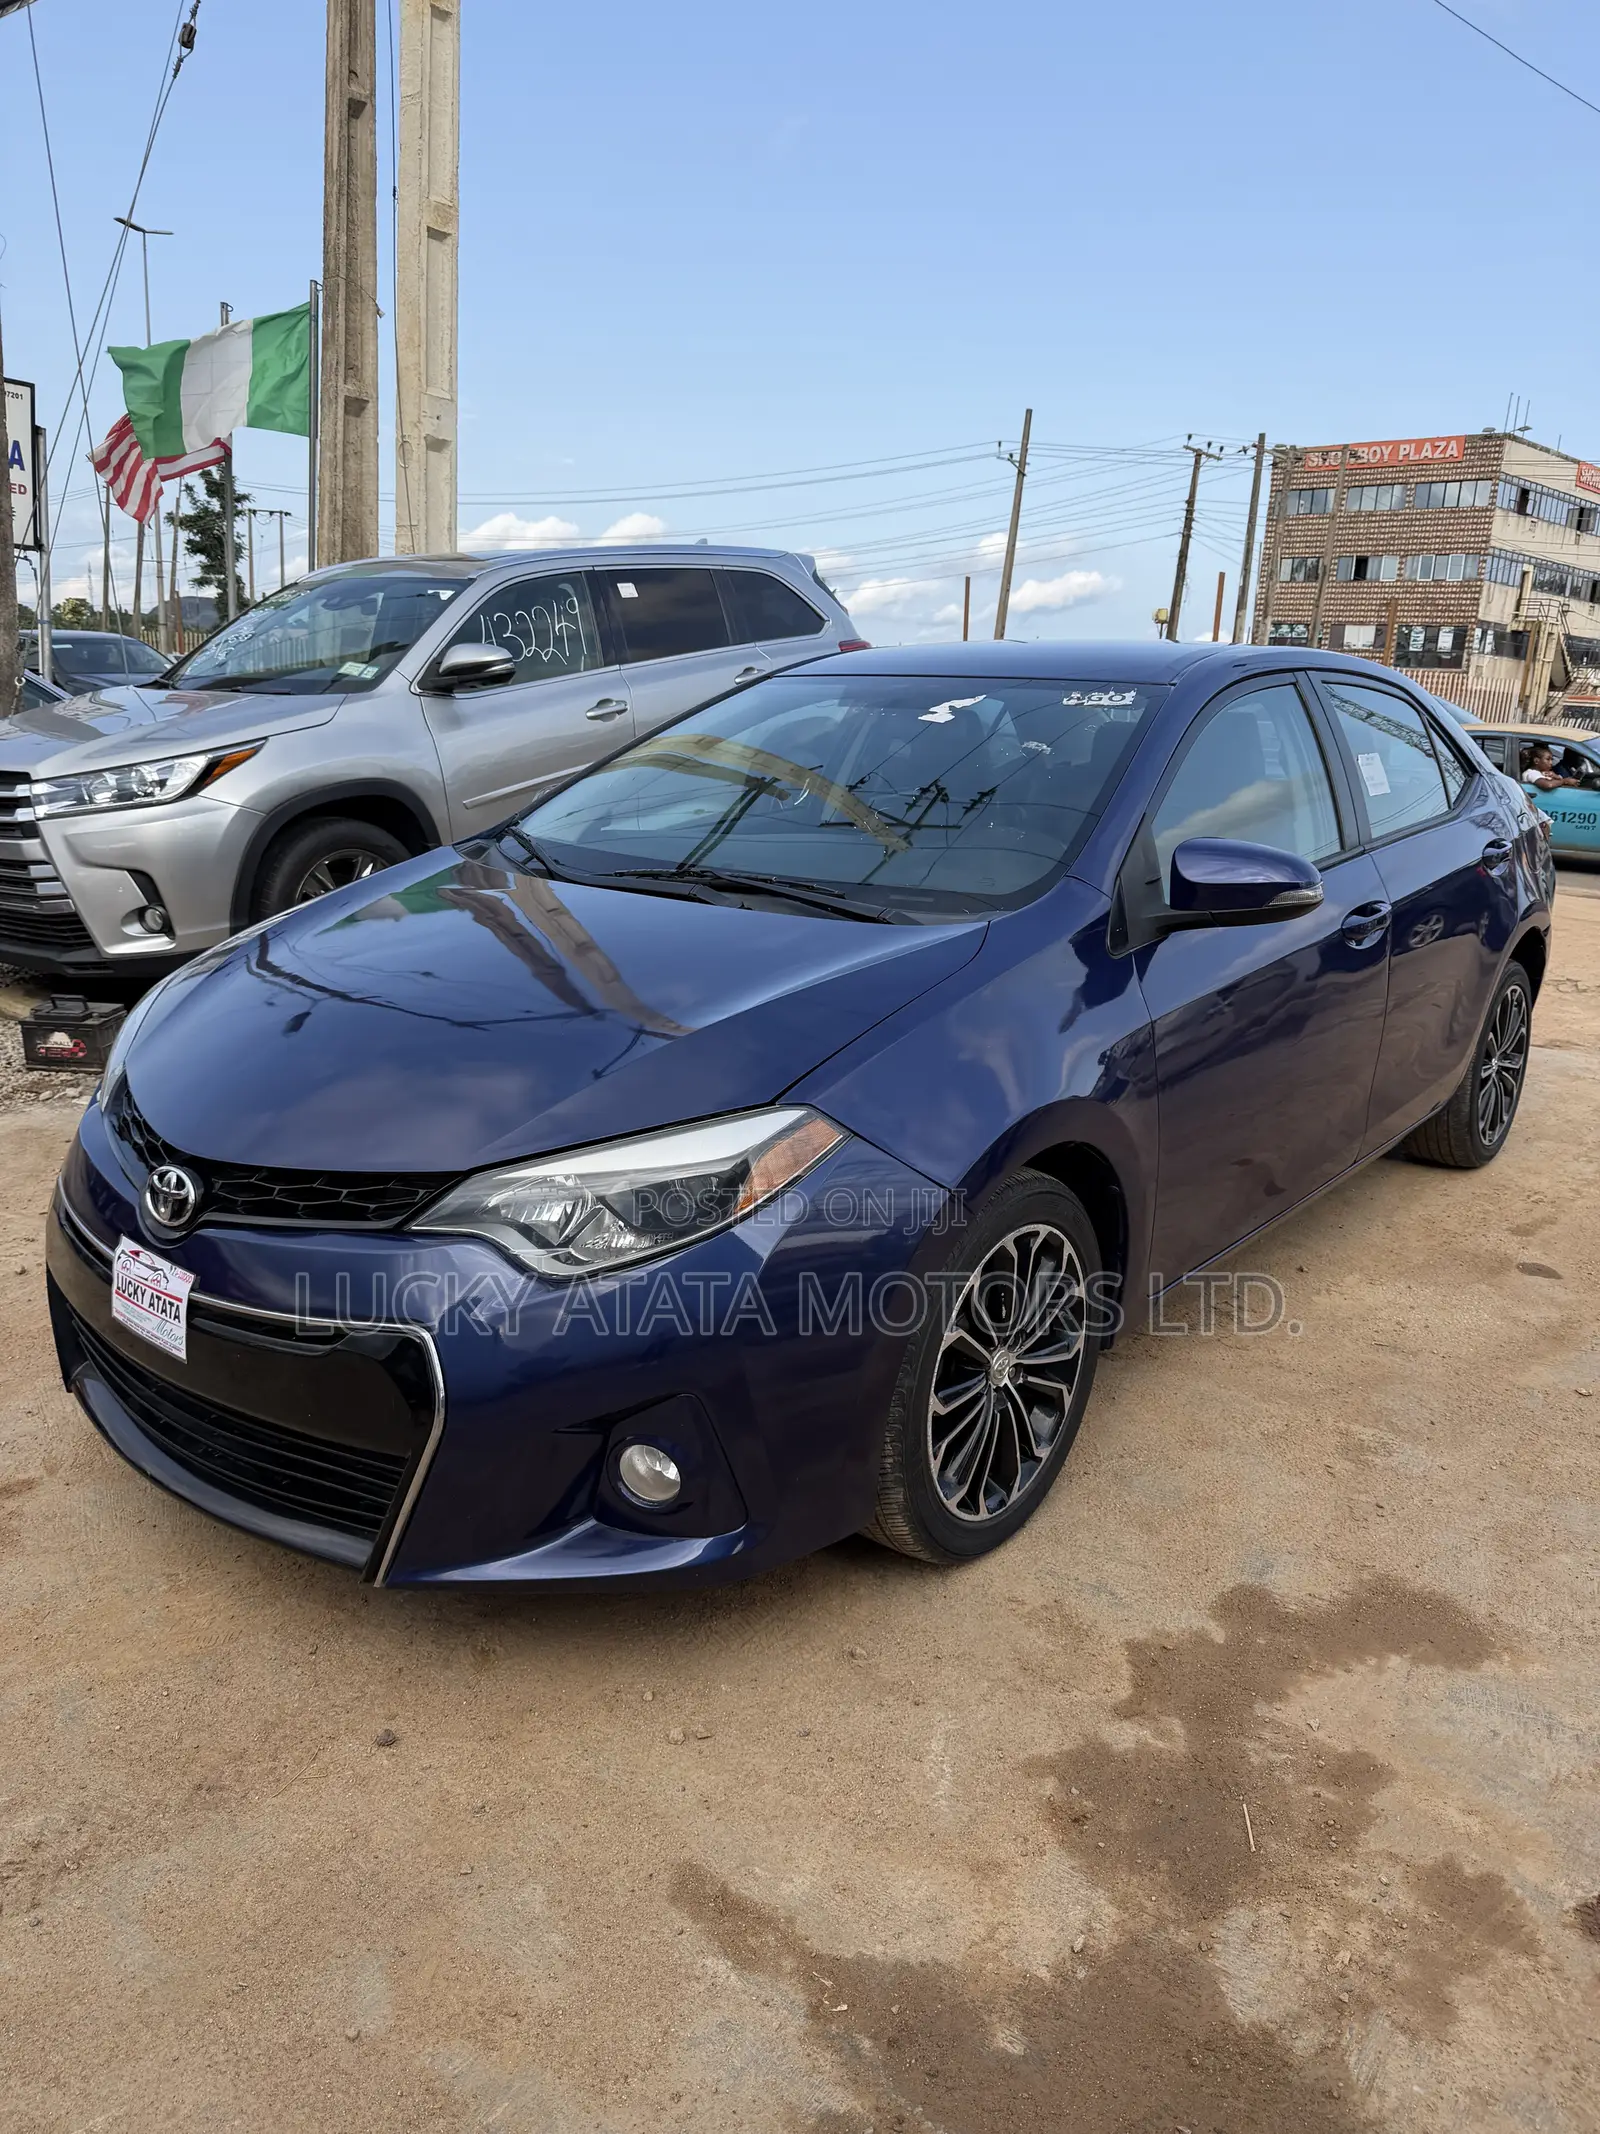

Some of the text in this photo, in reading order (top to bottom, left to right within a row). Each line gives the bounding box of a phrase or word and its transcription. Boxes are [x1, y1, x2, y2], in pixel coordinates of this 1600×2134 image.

[5, 390, 23, 400] 7201
[1400, 440, 1459, 461] PLAZA
[116, 1273, 147, 1304] LUCKY
[148, 1291, 181, 1323] ATATA
[152, 1319, 184, 1345] Motors
